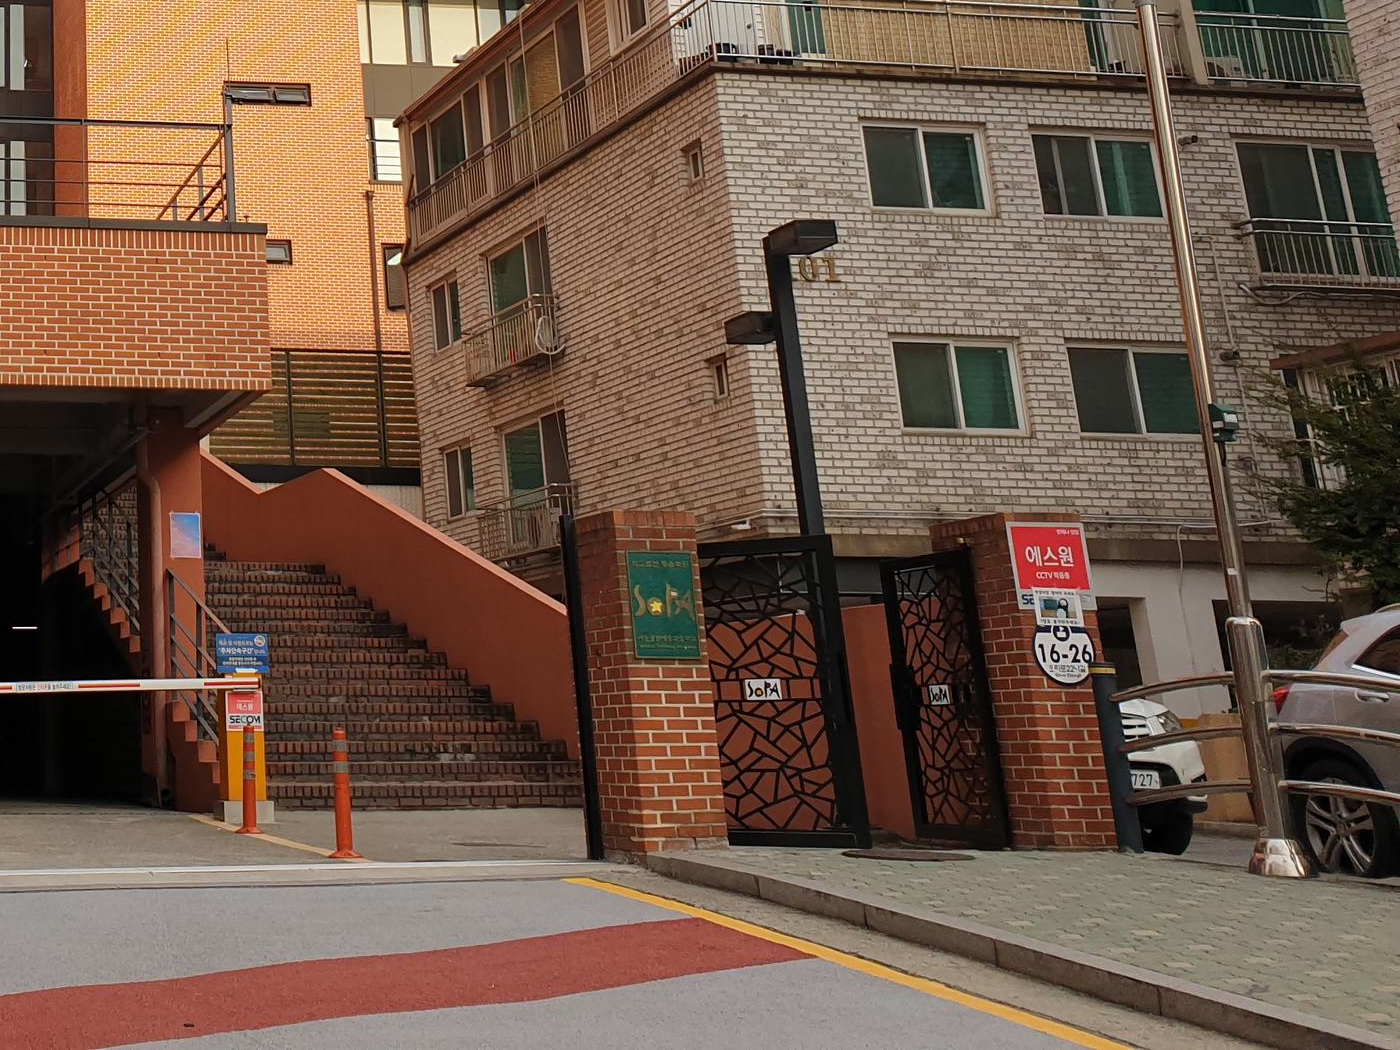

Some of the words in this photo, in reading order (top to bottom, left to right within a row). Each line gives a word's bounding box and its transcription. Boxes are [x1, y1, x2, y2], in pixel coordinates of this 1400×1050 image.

[1025, 546, 1075, 567] 에스원
[1036, 571, 1053, 580] CCTV
[1038, 643, 1093, 664] 16-26
[230, 716, 260, 724] SECOM
